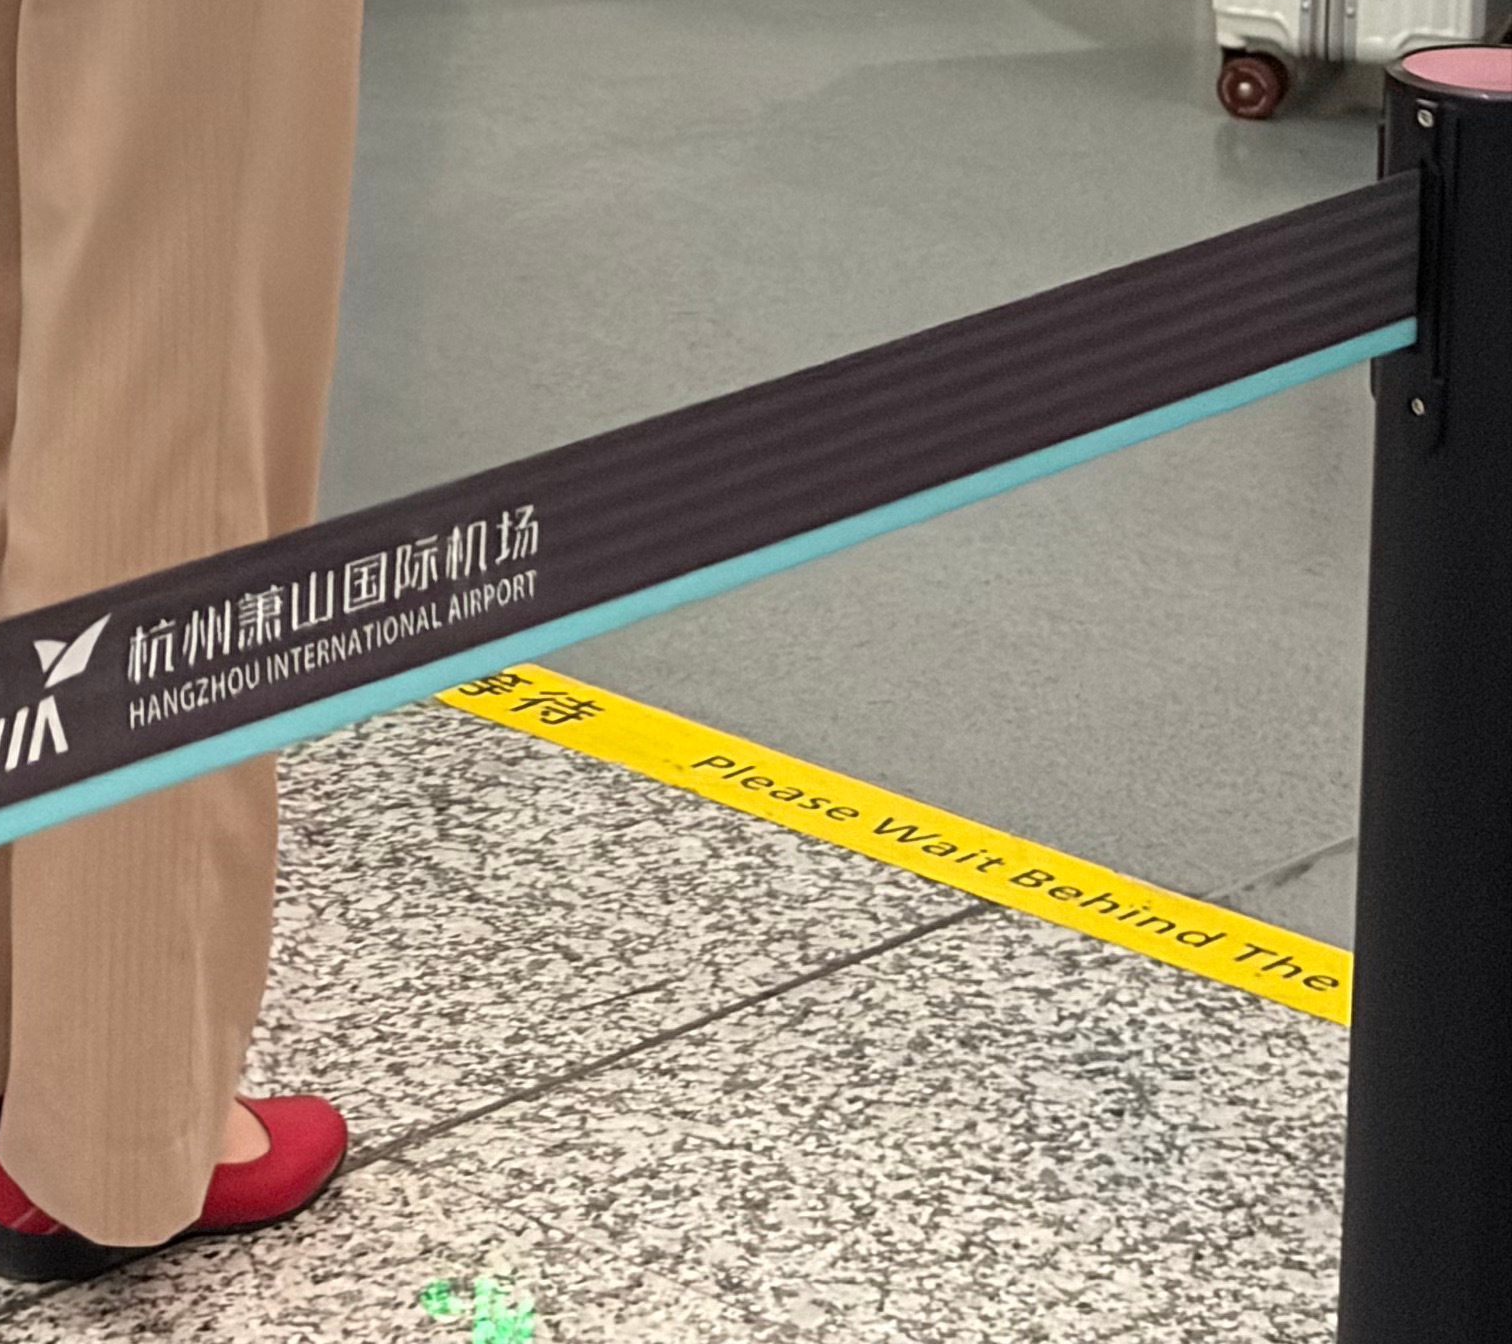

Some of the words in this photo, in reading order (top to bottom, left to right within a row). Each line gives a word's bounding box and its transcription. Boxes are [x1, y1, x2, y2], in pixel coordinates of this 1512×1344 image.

[127, 504, 540, 685] 杭州萧山国际机场
[129, 660, 261, 730] HANGZHOU
[266, 610, 442, 679] INTERNATIONAL
[448, 570, 539, 623] AIRPORT
[690, 753, 862, 823] Please
[873, 815, 1003, 875] Wait
[1008, 867, 1223, 949] Behind
[1232, 942, 1342, 995] The
